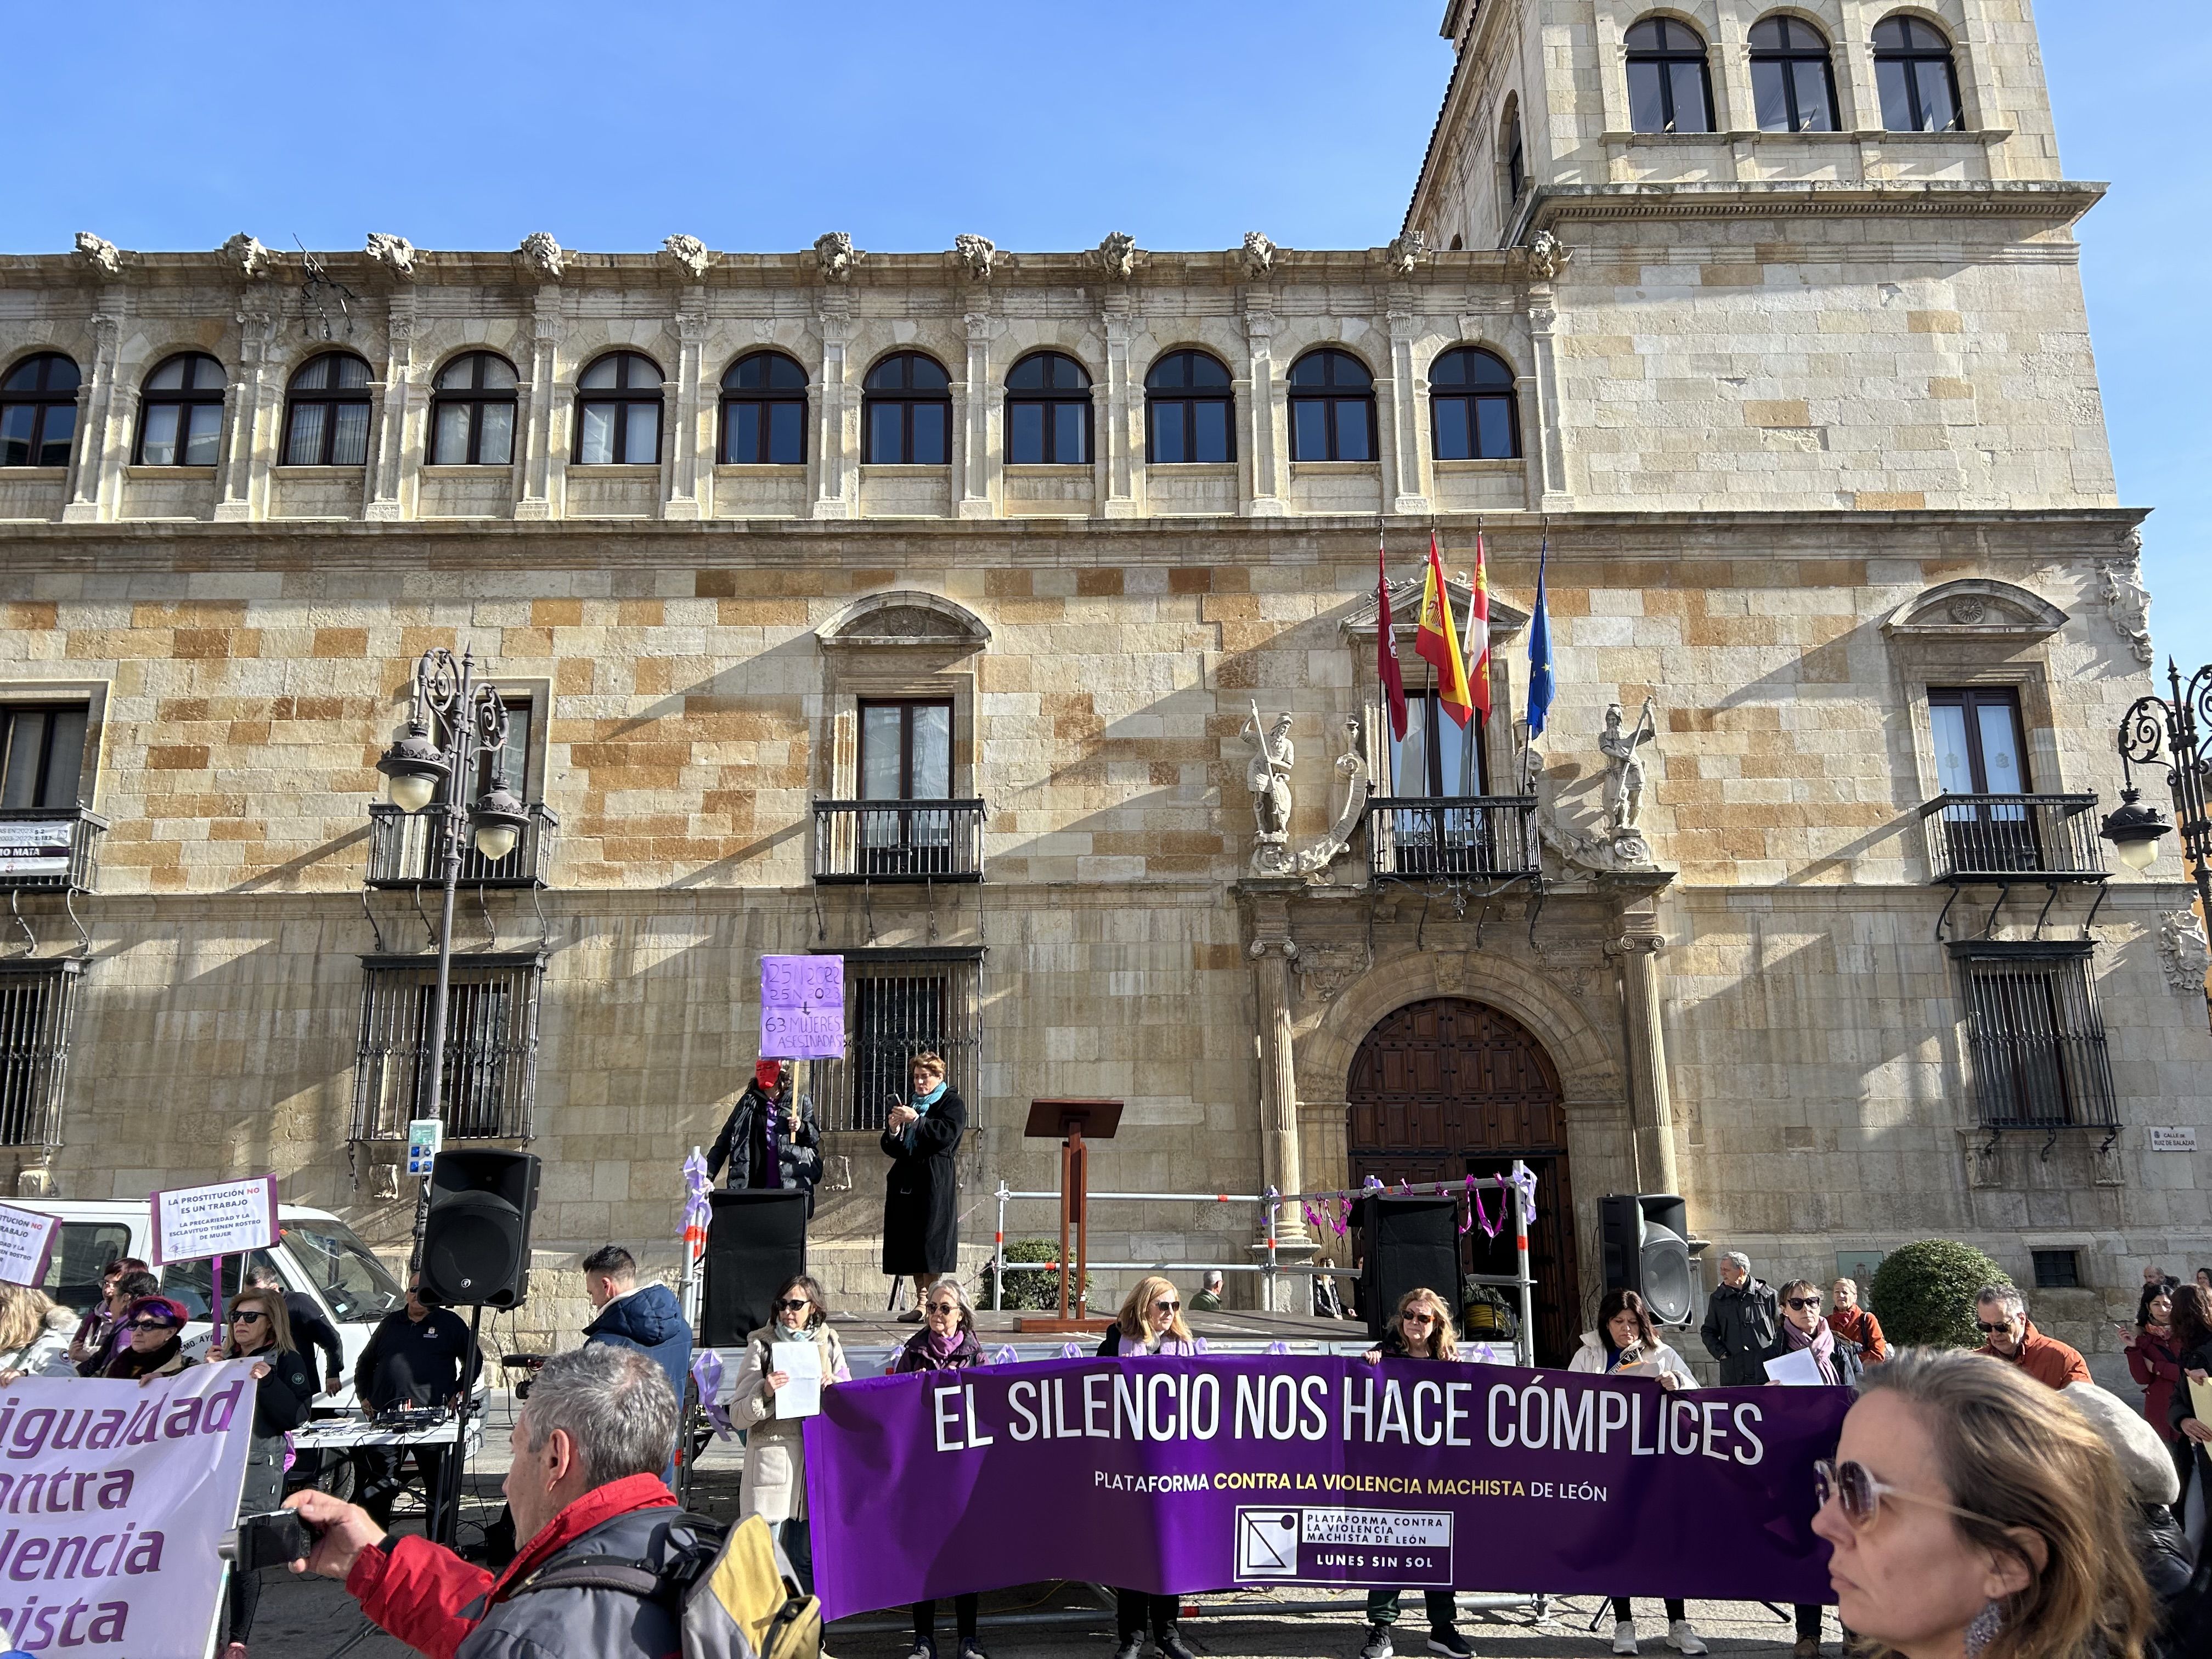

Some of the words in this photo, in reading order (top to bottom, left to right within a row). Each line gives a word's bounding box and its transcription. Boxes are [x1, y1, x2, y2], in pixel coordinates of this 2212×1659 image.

[13, 848, 40, 856] MATA
[807, 987, 840, 999] 2023
[765, 1017, 786, 1033] 63
[789, 1016, 841, 1034] MUJERES
[777, 1034, 844, 1048] ASESINADAS
[181, 1188, 244, 1204] PROSTITUCIÓN
[207, 1199, 248, 1210] TRABAJO
[30, 1222, 43, 1231] NO
[189, 1216, 234, 1226] PRECARIEDAD
[169, 1227, 208, 1237] ESCLAVITUD
[210, 1223, 233, 1231] TIENEN
[235, 1219, 261, 1227] ROSTRO
[210, 1231, 232, 1239] MUJER
[9, 1251, 31, 1261] ROSTRO
[934, 1383, 994, 1453] EL
[1008, 1373, 1220, 1442] SILENCIO
[1234, 1374, 1328, 1441] NOS
[1344, 1376, 1472, 1447] HACE
[1487, 1375, 1764, 1466] CÓMPLICES
[1094, 1470, 1210, 1493] PLATAFORMA
[1214, 1472, 1291, 1491] CONTRA
[1296, 1473, 1318, 1491] LA
[1322, 1474, 1422, 1494] VIOLENCIA
[1426, 1478, 1525, 1497] MACHISTA
[1531, 1481, 1553, 1499] DE
[1559, 1479, 1607, 1502] LEÓN
[1307, 1514, 1387, 1526] PLATAFORMA
[1394, 1517, 1443, 1527] CONTRA
[1307, 1524, 1321, 1532] LA
[1327, 1524, 1394, 1535] VIOLENCIA
[1307, 1533, 1369, 1543] MACHISTA
[1375, 1535, 1390, 1544] DE
[1396, 1534, 1427, 1545] LEÓN
[1317, 1554, 1365, 1567] LUNES
[1372, 1556, 1398, 1568] SIN
[1406, 1557, 1434, 1568] SOL
